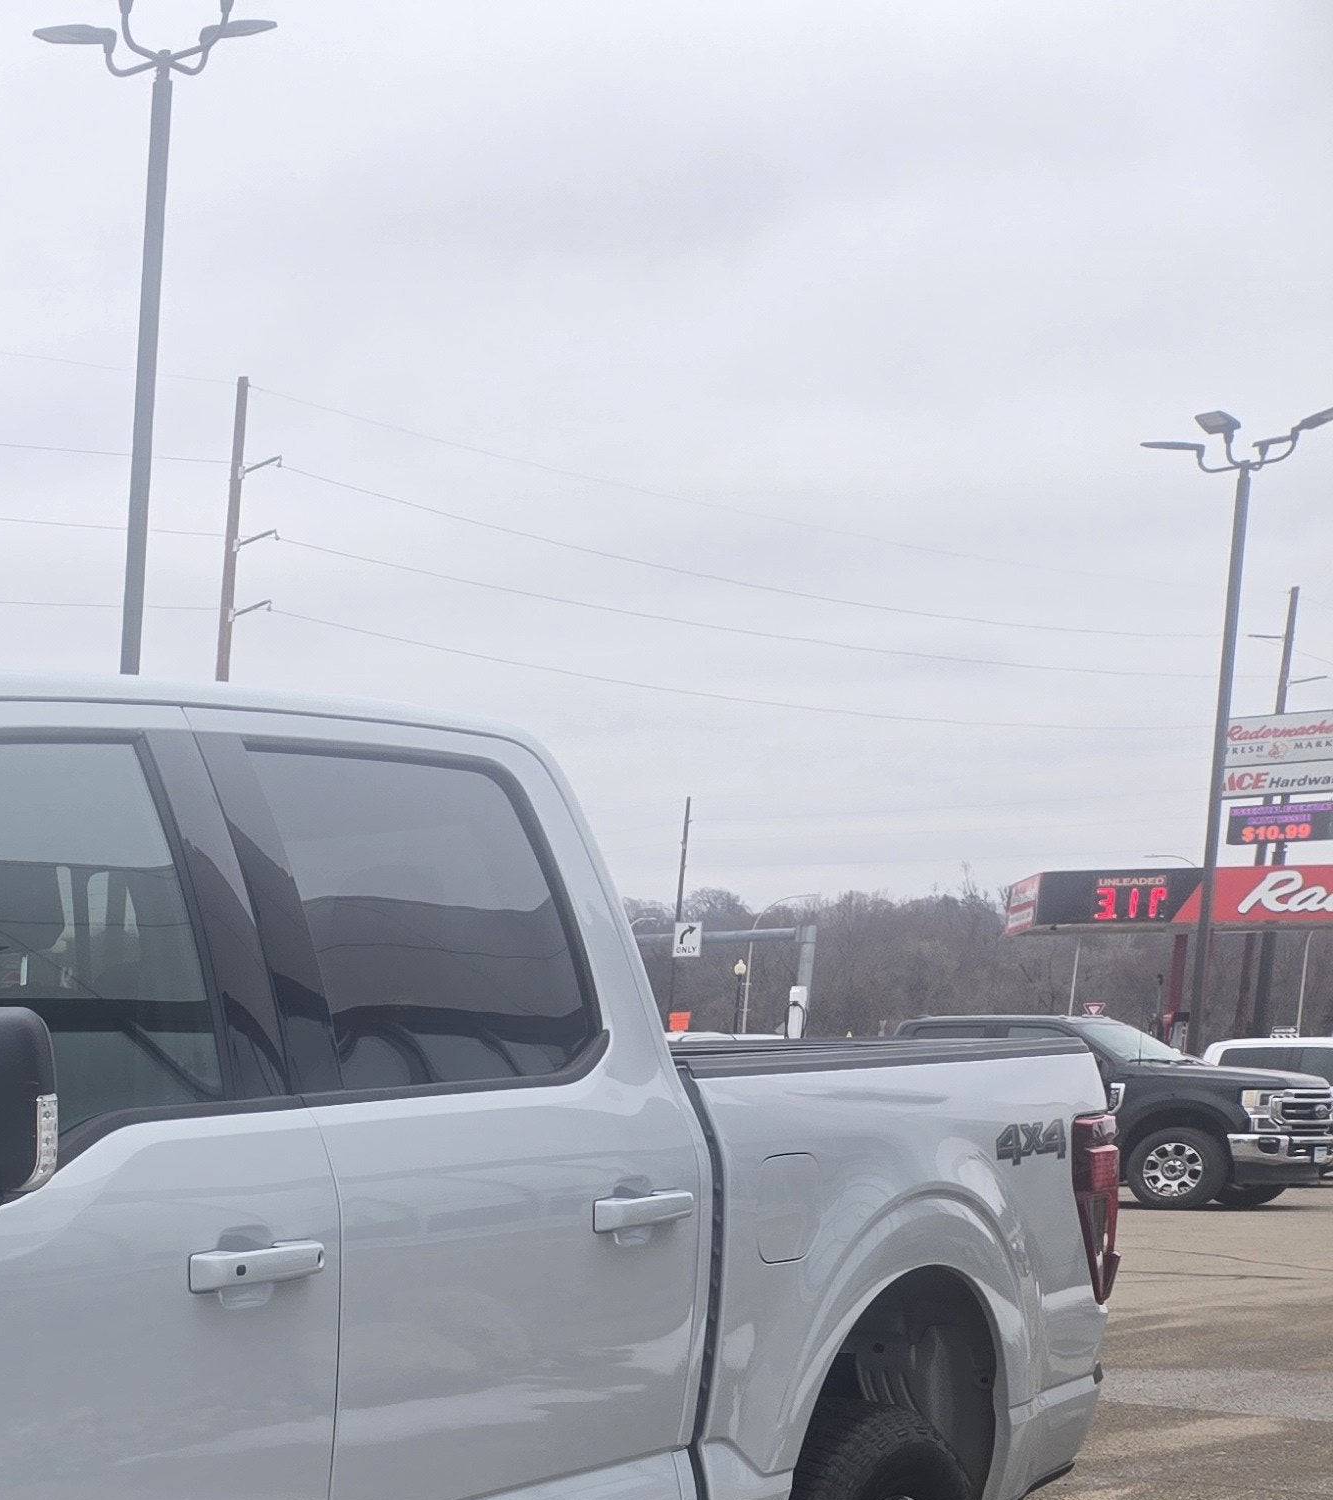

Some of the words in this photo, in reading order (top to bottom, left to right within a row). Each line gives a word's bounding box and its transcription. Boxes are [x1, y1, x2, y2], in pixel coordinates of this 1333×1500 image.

[1222, 772, 1269, 791] ACE
[1269, 775, 1333, 788] Hardwa
[1099, 876, 1165, 886] UNLEADED
[675, 946, 697, 954] ONLY
